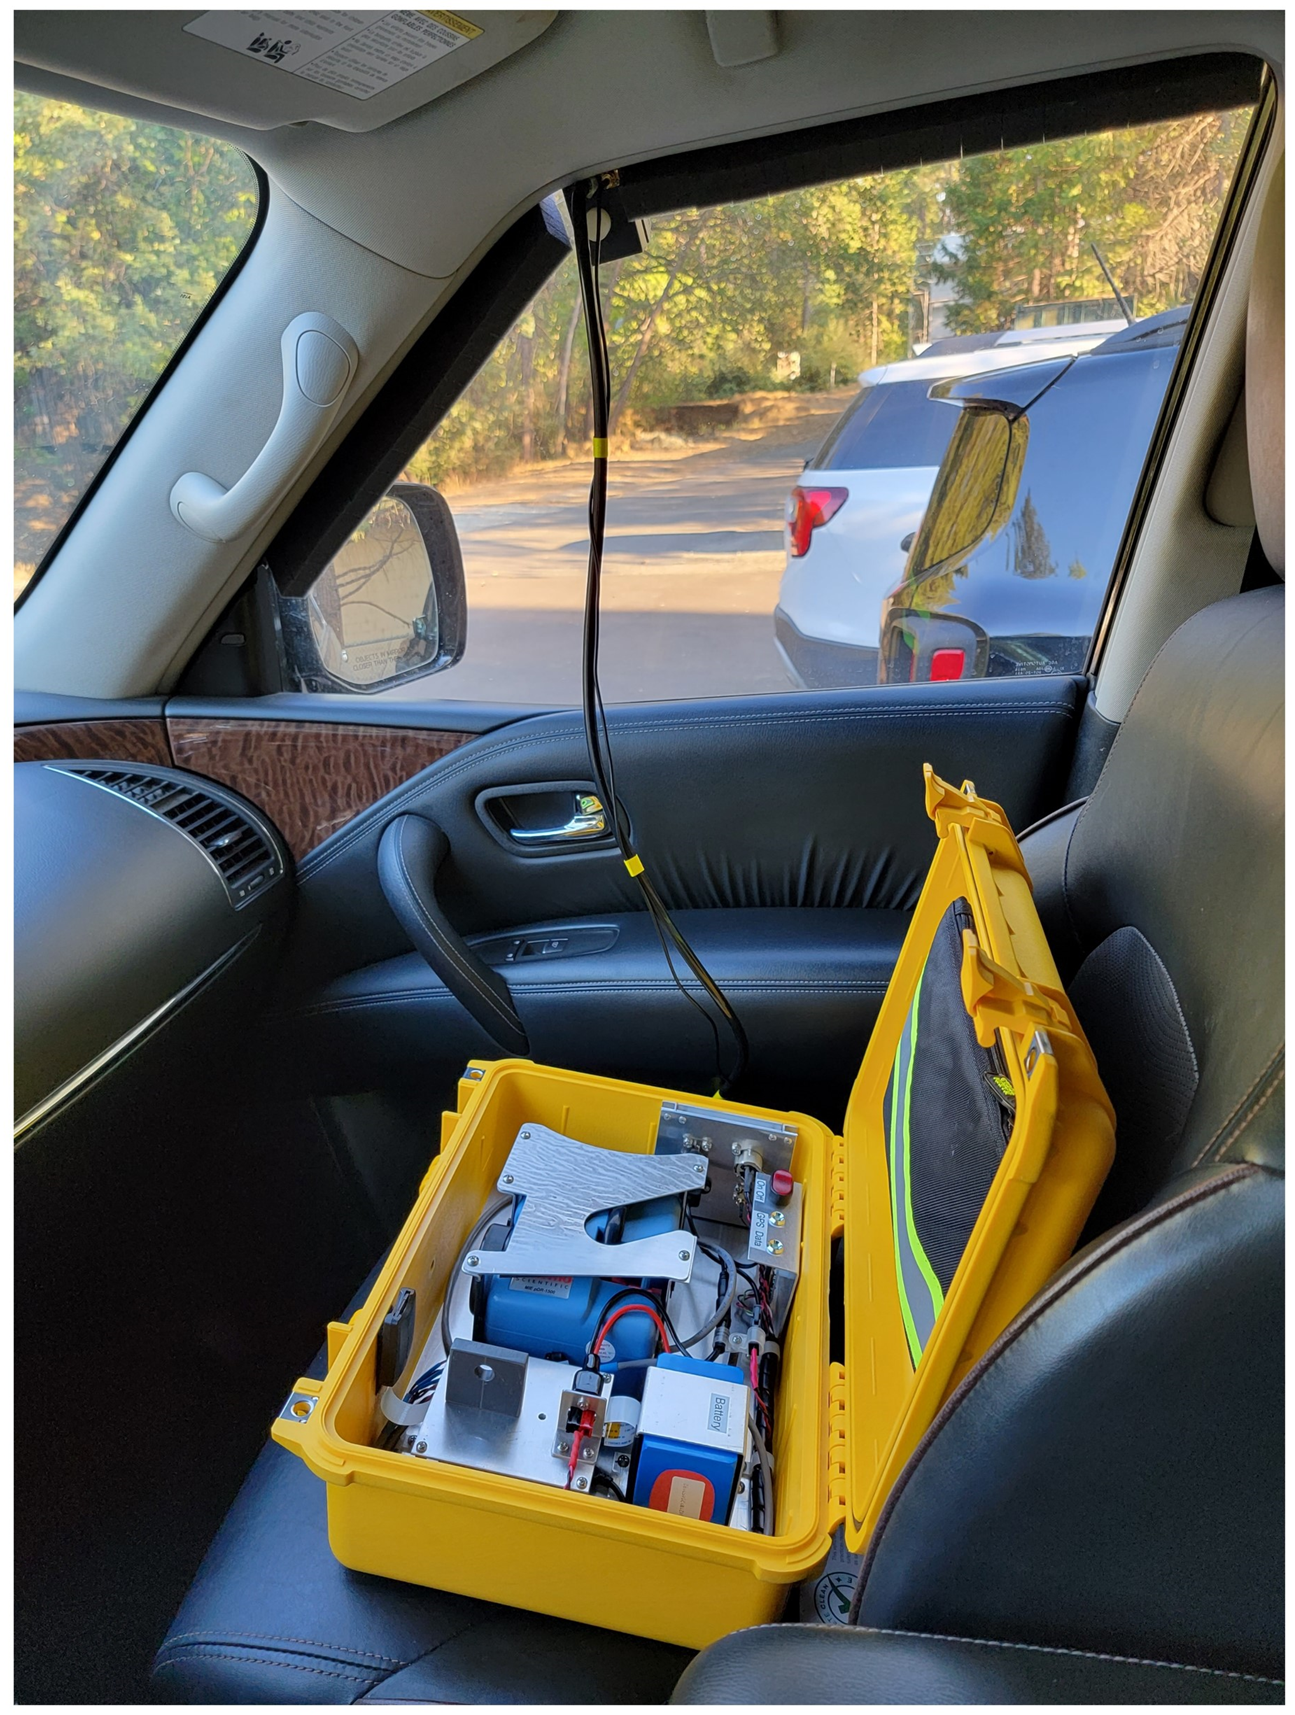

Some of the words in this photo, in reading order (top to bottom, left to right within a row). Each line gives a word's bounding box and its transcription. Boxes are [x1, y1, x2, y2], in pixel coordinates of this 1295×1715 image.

[355, 652, 380, 664] OBJECTS
[352, 662, 373, 672] CLOSER
[756, 1180, 765, 1190] On
[755, 1213, 765, 1229] GPS
[754, 1230, 764, 1247] Data
[710, 1397, 726, 1432] Battery
[818, 1584, 829, 1610] CLEAN
